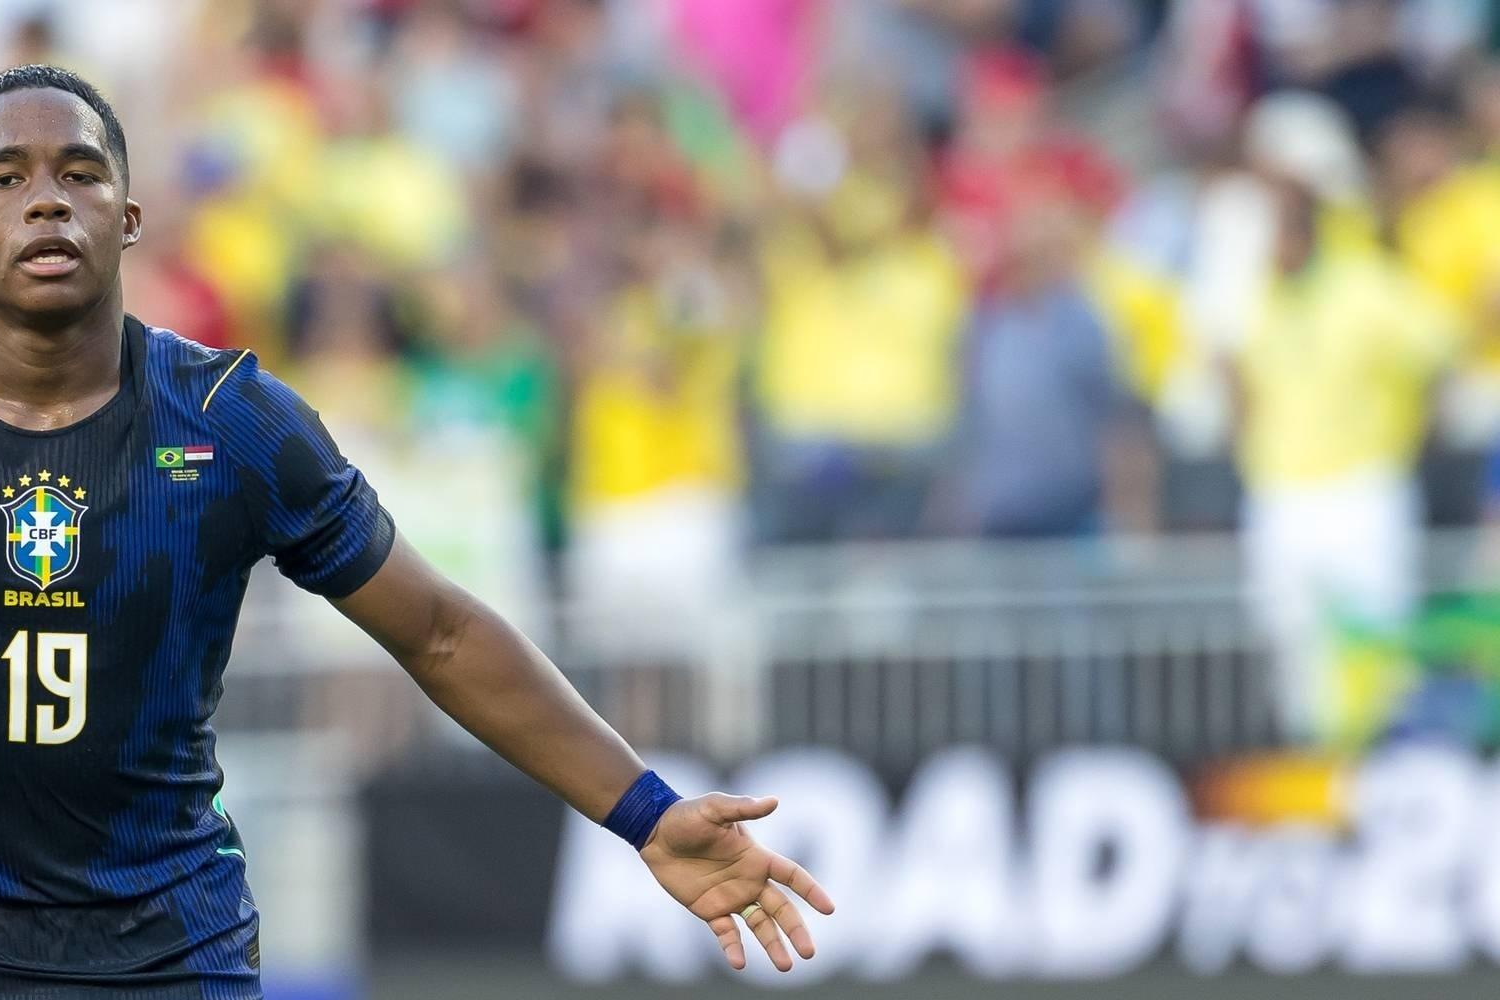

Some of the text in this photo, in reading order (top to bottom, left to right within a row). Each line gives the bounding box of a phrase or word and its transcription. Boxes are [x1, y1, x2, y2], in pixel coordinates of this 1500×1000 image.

[29, 528, 58, 540] CBF
[4, 590, 85, 608] BRASIL
[1, 630, 88, 745] 19
